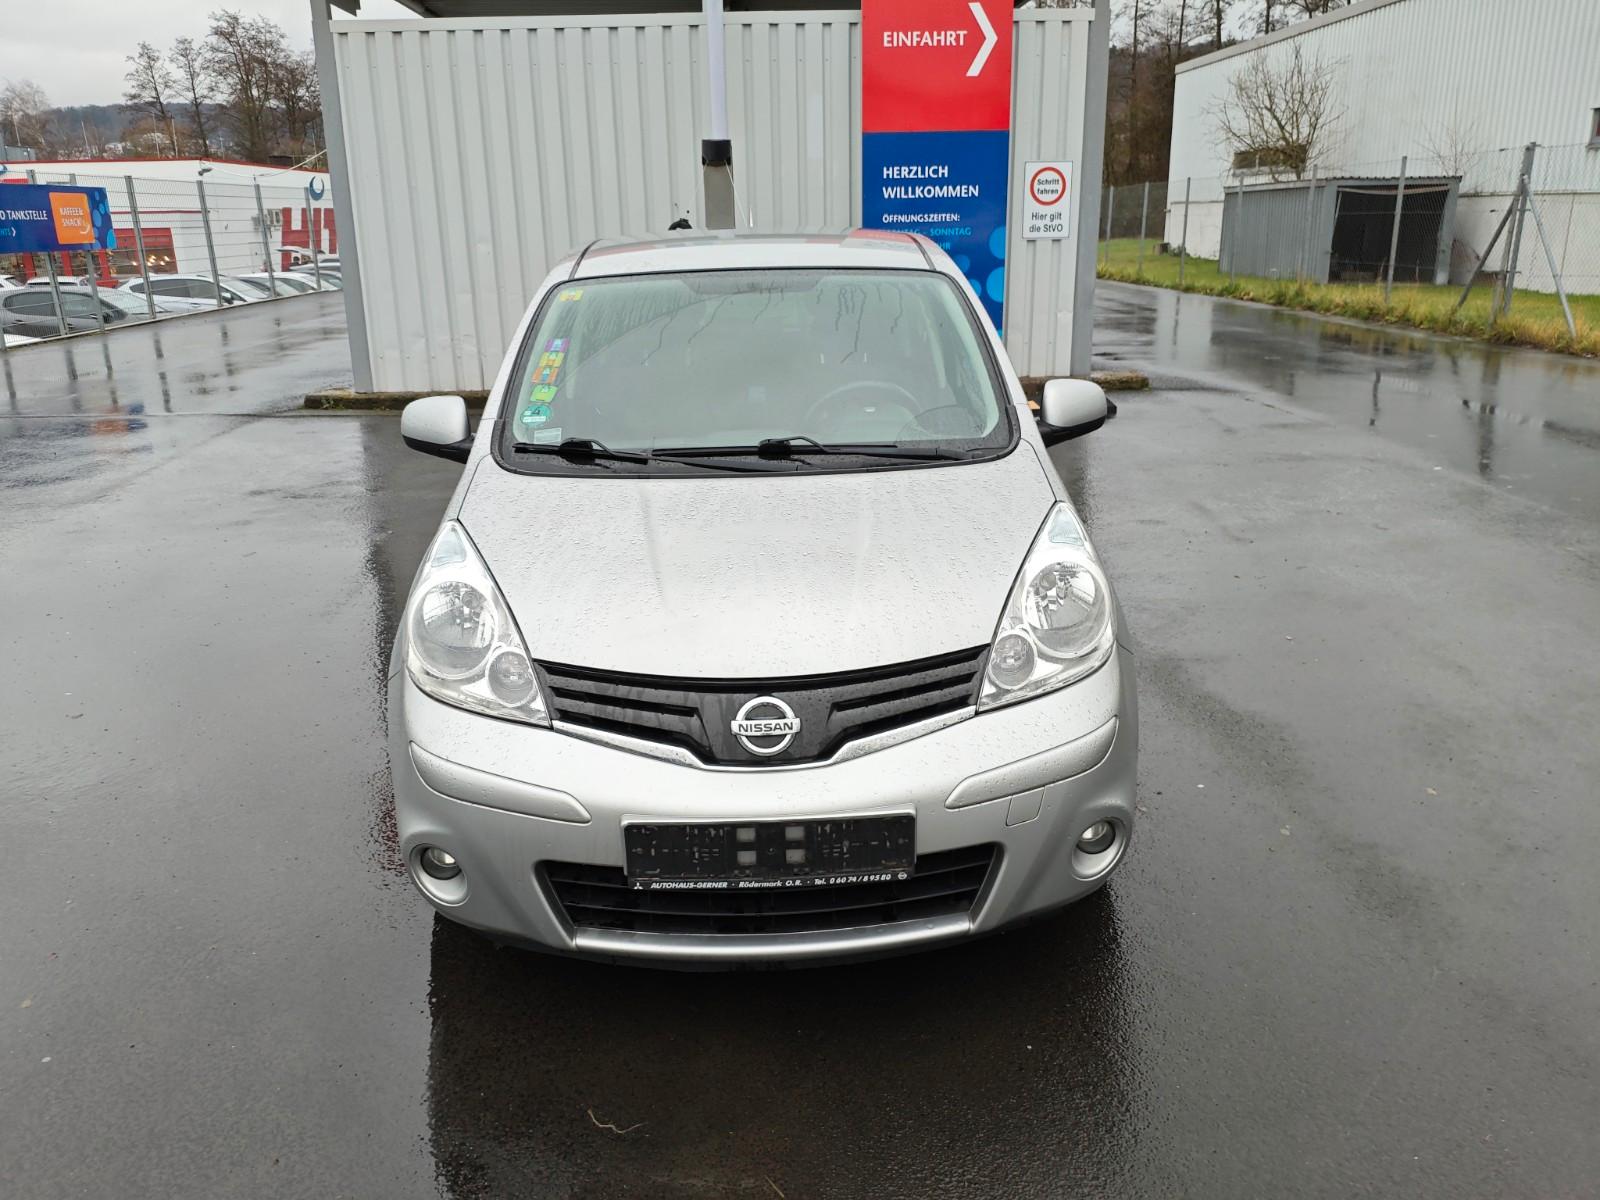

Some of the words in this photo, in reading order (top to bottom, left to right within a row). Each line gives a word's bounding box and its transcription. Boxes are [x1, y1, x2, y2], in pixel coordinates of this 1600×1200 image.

[883, 30, 968, 47] EINFAHRT
[883, 165, 948, 179] HERZLICH
[1037, 178, 1059, 186] Schritt
[882, 184, 979, 199] WILLKOMMEN
[6, 210, 48, 220] TANKSTELLE
[882, 212, 960, 223] ÖFFNUNGSZEITEN:
[1031, 211, 1047, 220] Hier
[1049, 212, 1062, 222] gilt
[930, 227, 971, 236] SONNTAG
[1029, 224, 1041, 233] die
[1043, 223, 1063, 232] StVO
[738, 721, 793, 733] NISSAN
[650, 881, 728, 889] AUTOHAUS-GERNER
[738, 880, 782, 888] Rödermark
[814, 877, 826, 885] Tel.
